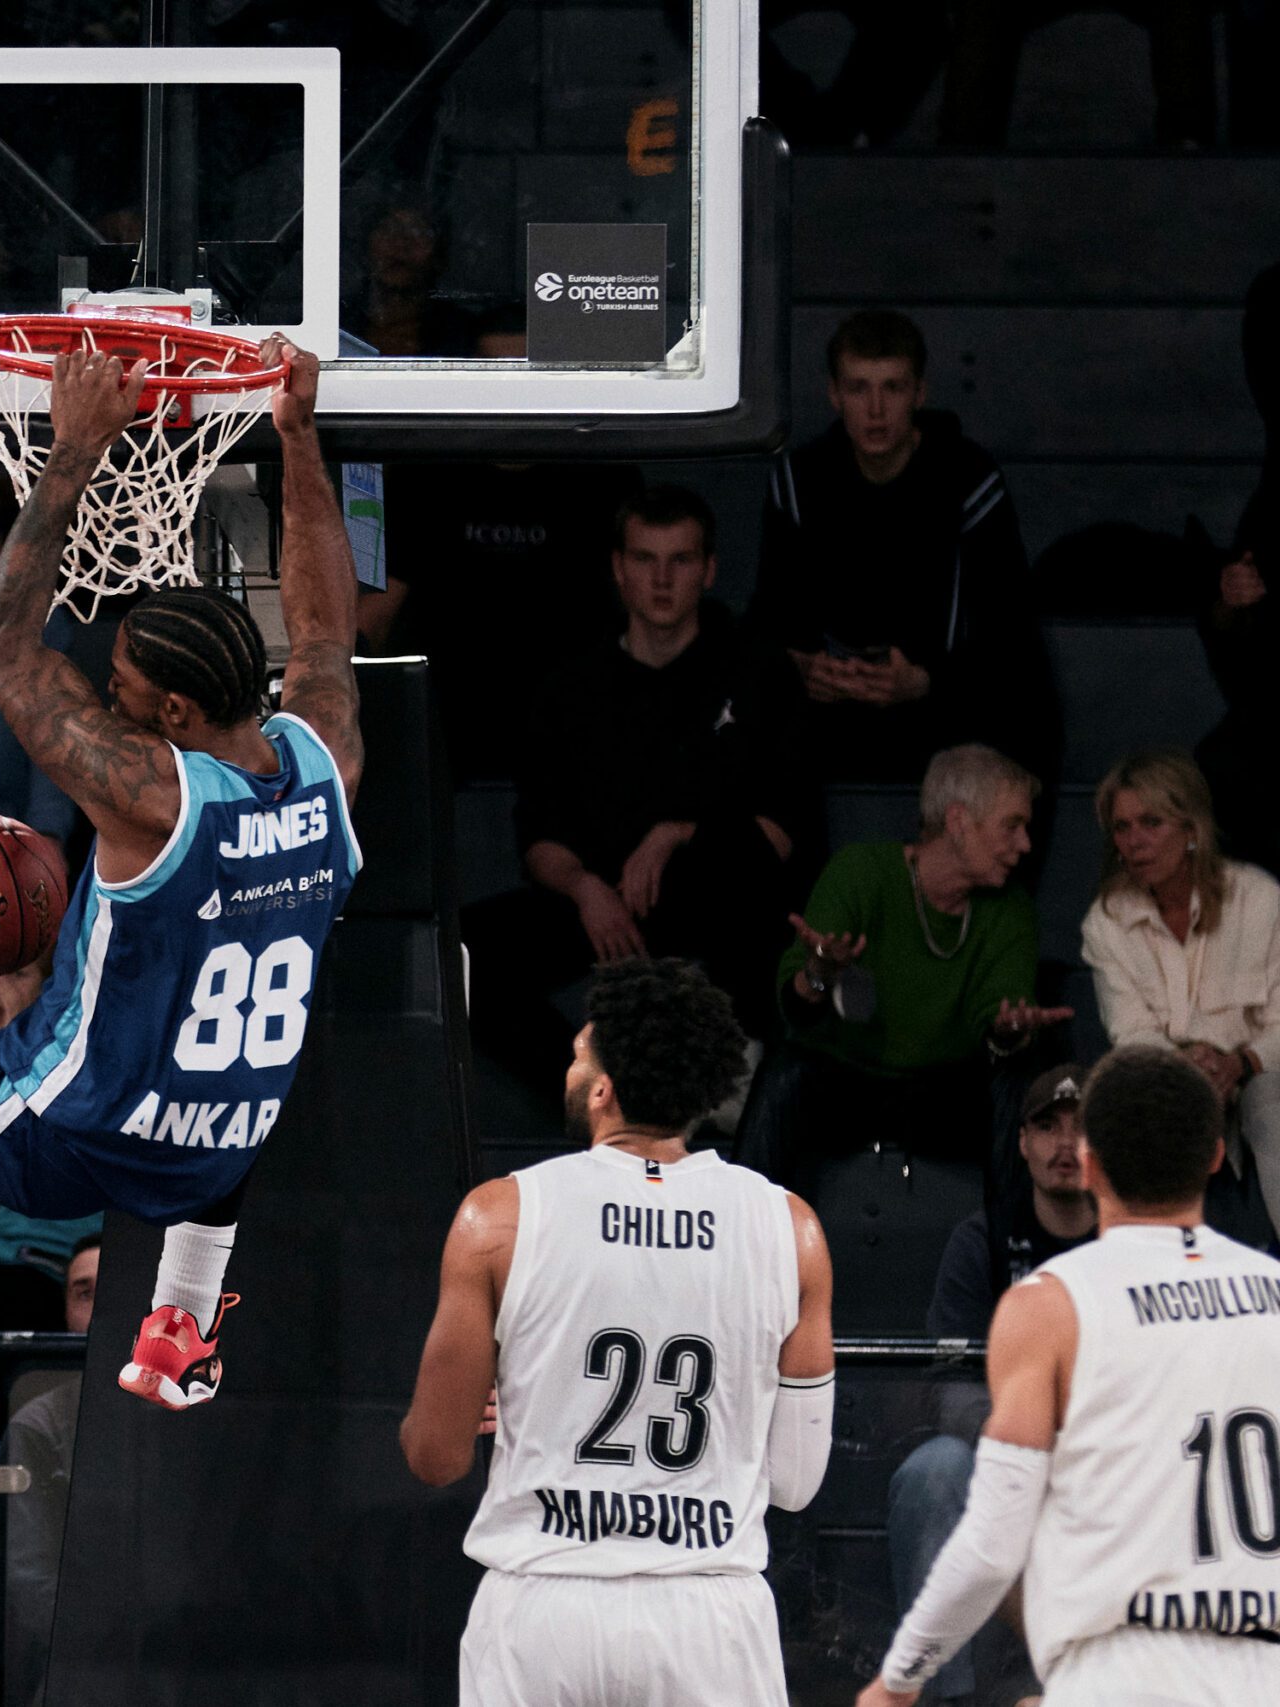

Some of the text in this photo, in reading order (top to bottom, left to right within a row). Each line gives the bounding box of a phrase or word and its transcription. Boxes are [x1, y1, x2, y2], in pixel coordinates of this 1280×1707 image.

[625, 97, 679, 177] E
[567, 283, 659, 300] oneteam
[568, 274, 659, 285] Euroleague Basketball
[596, 303, 659, 311] TURKISH AIRLINES
[219, 795, 329, 859] JONES
[229, 877, 294, 902] ANKARA
[172, 935, 315, 1072] 88
[601, 1202, 716, 1251] CHILDS
[574, 1327, 717, 1473] 23
[1181, 1406, 1280, 1565] 10
[534, 1488, 735, 1550] HAMBURG
